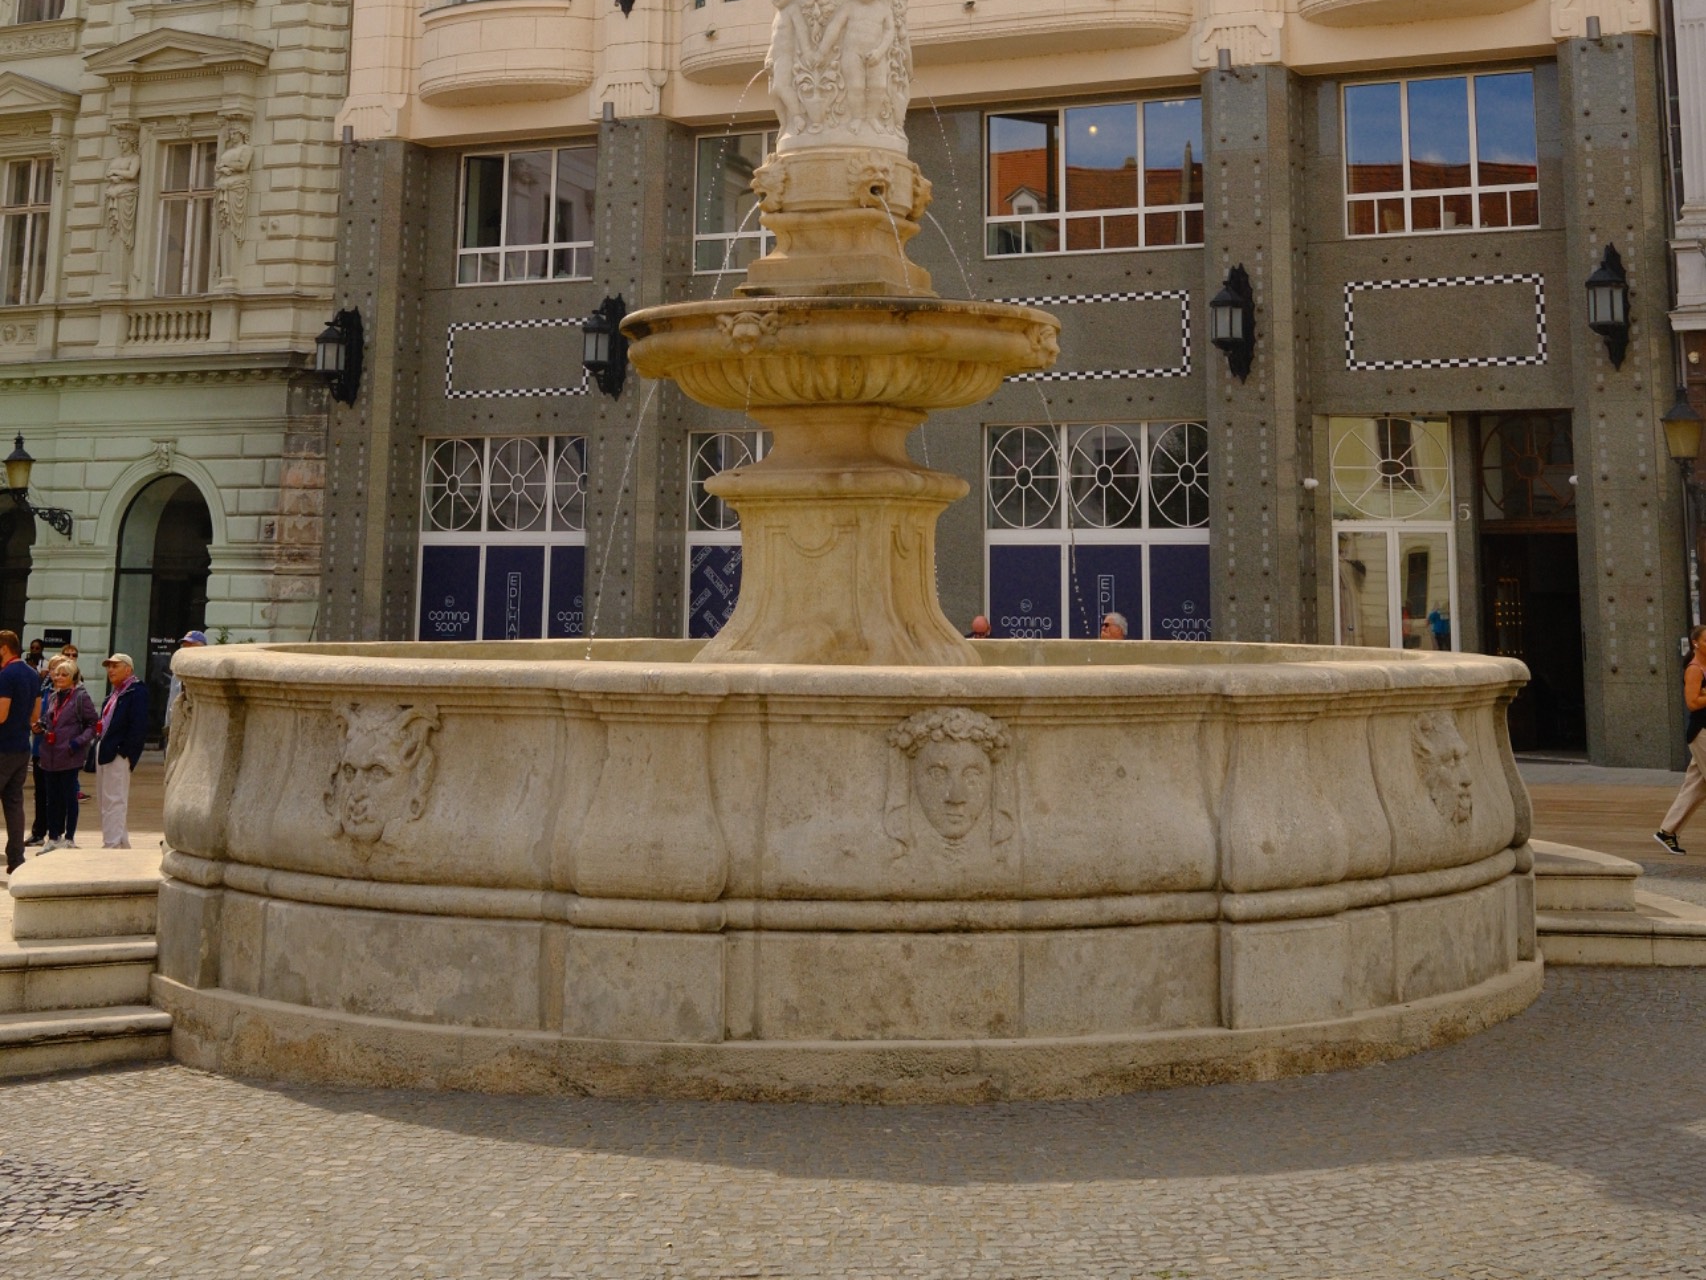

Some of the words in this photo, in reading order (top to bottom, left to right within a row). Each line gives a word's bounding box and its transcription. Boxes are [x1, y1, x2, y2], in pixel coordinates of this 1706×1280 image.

[1459, 503, 1471, 521] 5
[428, 610, 470, 624] coming
[1001, 616, 1052, 630] coming
[435, 622, 462, 632] soon
[1009, 628, 1043, 639] soon
[1171, 631, 1206, 641] soon
